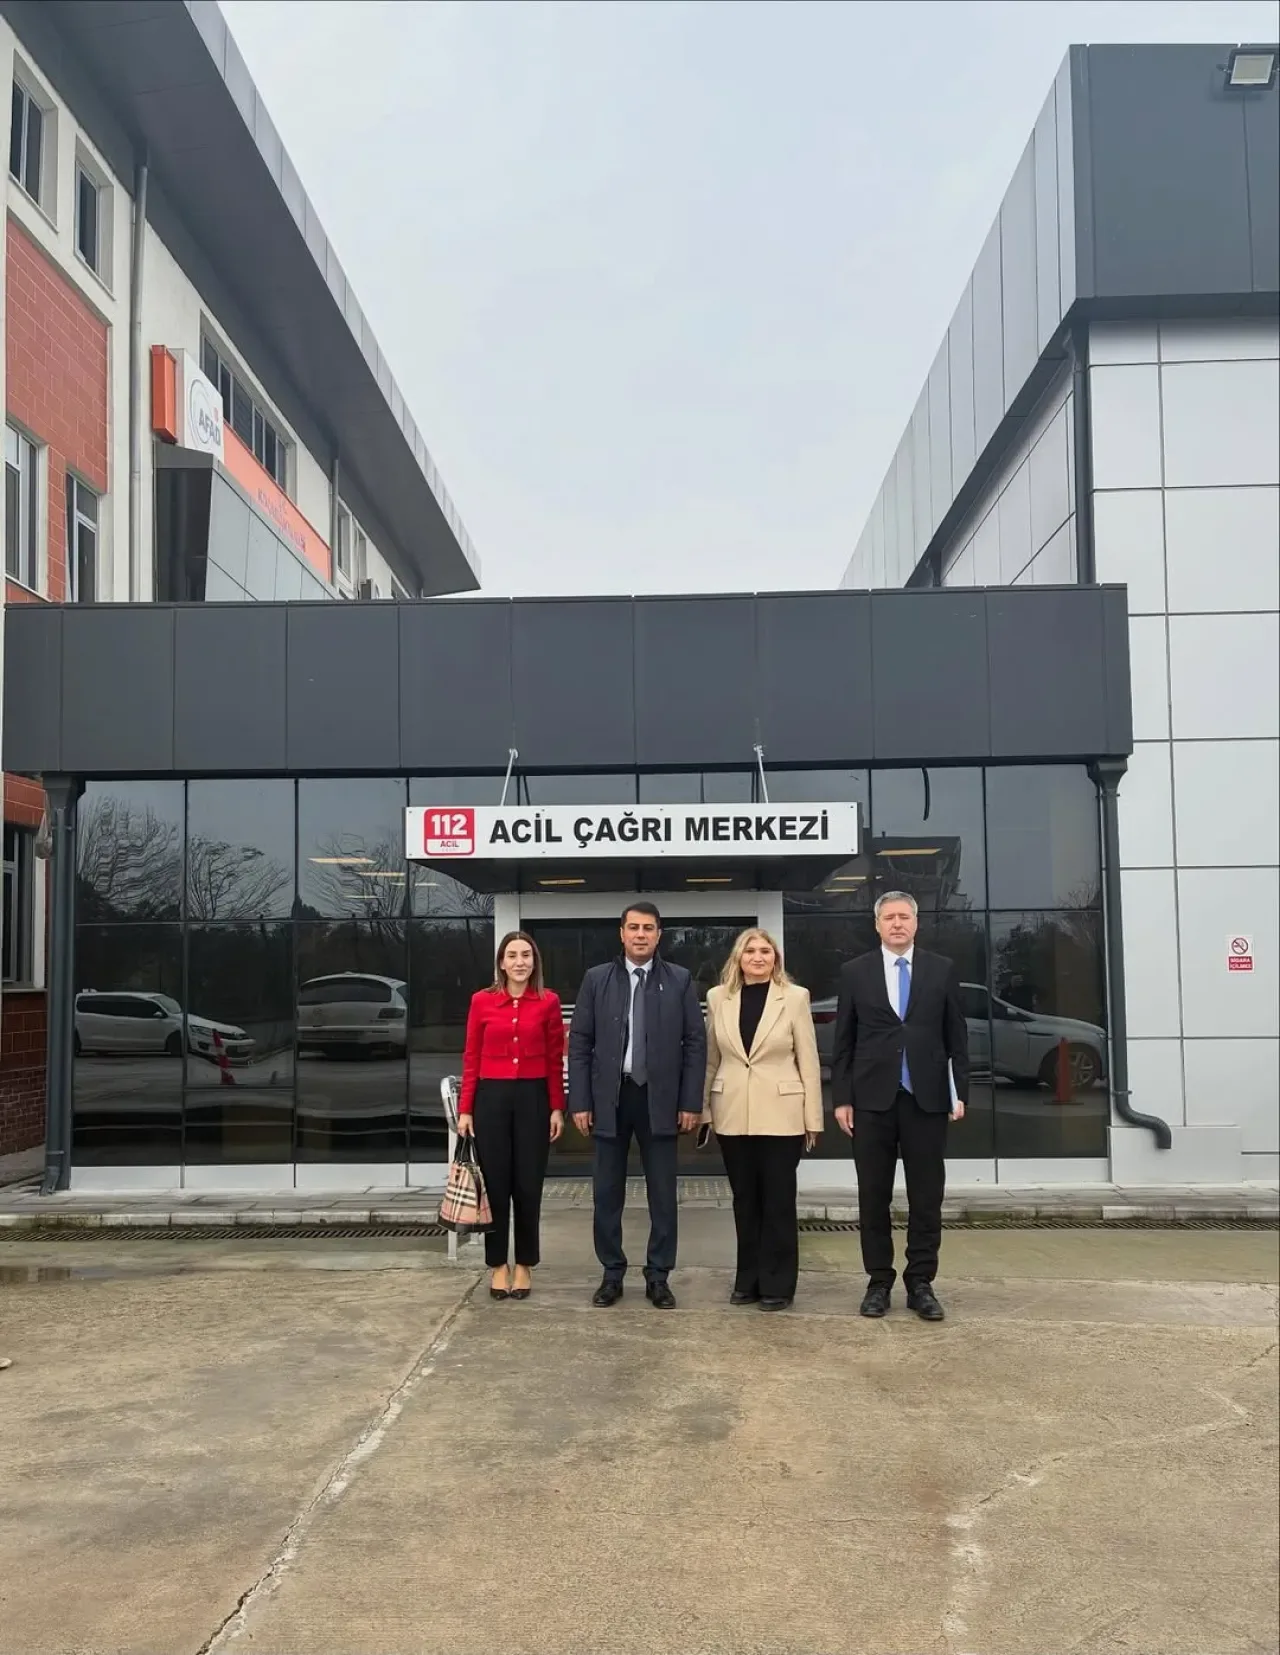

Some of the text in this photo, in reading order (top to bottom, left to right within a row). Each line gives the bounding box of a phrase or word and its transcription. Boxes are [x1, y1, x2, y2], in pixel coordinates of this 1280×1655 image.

[199, 408, 221, 446] AFAD
[431, 813, 468, 836] 112
[489, 809, 829, 848] ACİL ÇAĞRI MERKEZİ
